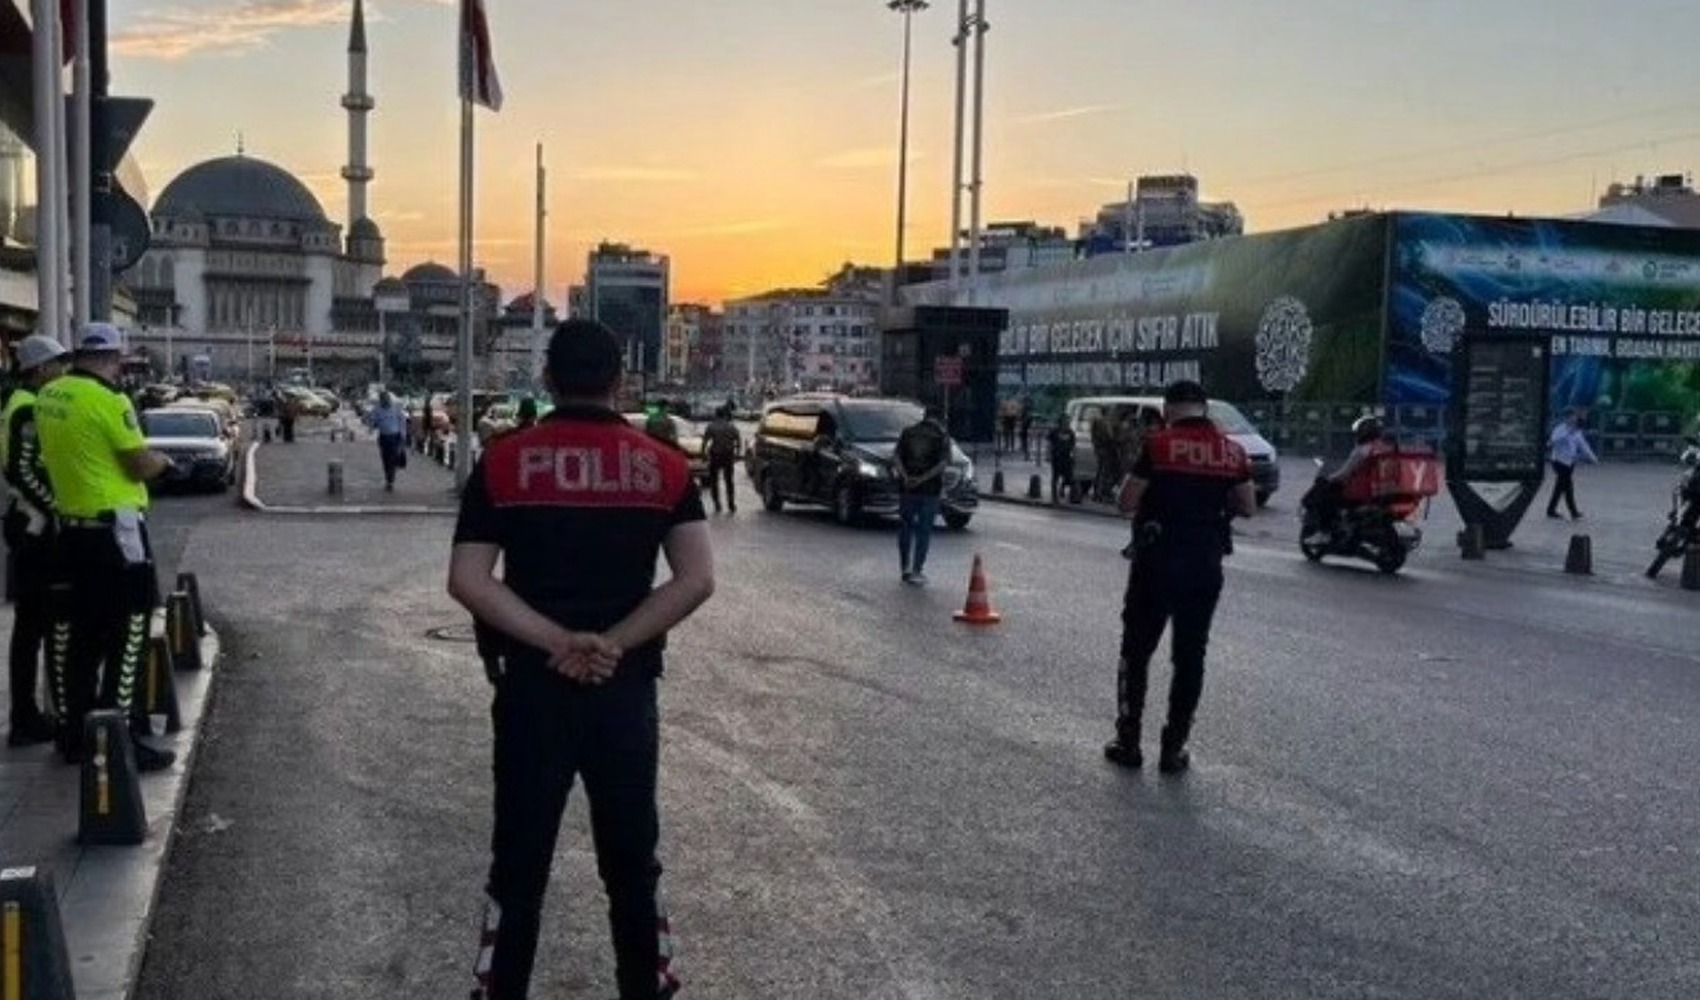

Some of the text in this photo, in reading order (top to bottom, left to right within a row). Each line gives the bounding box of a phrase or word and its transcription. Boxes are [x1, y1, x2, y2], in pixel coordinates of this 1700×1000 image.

[1181, 311, 1219, 348] ATIK
[1621, 303, 1646, 334] BİR
[1411, 461, 1427, 491] Y
